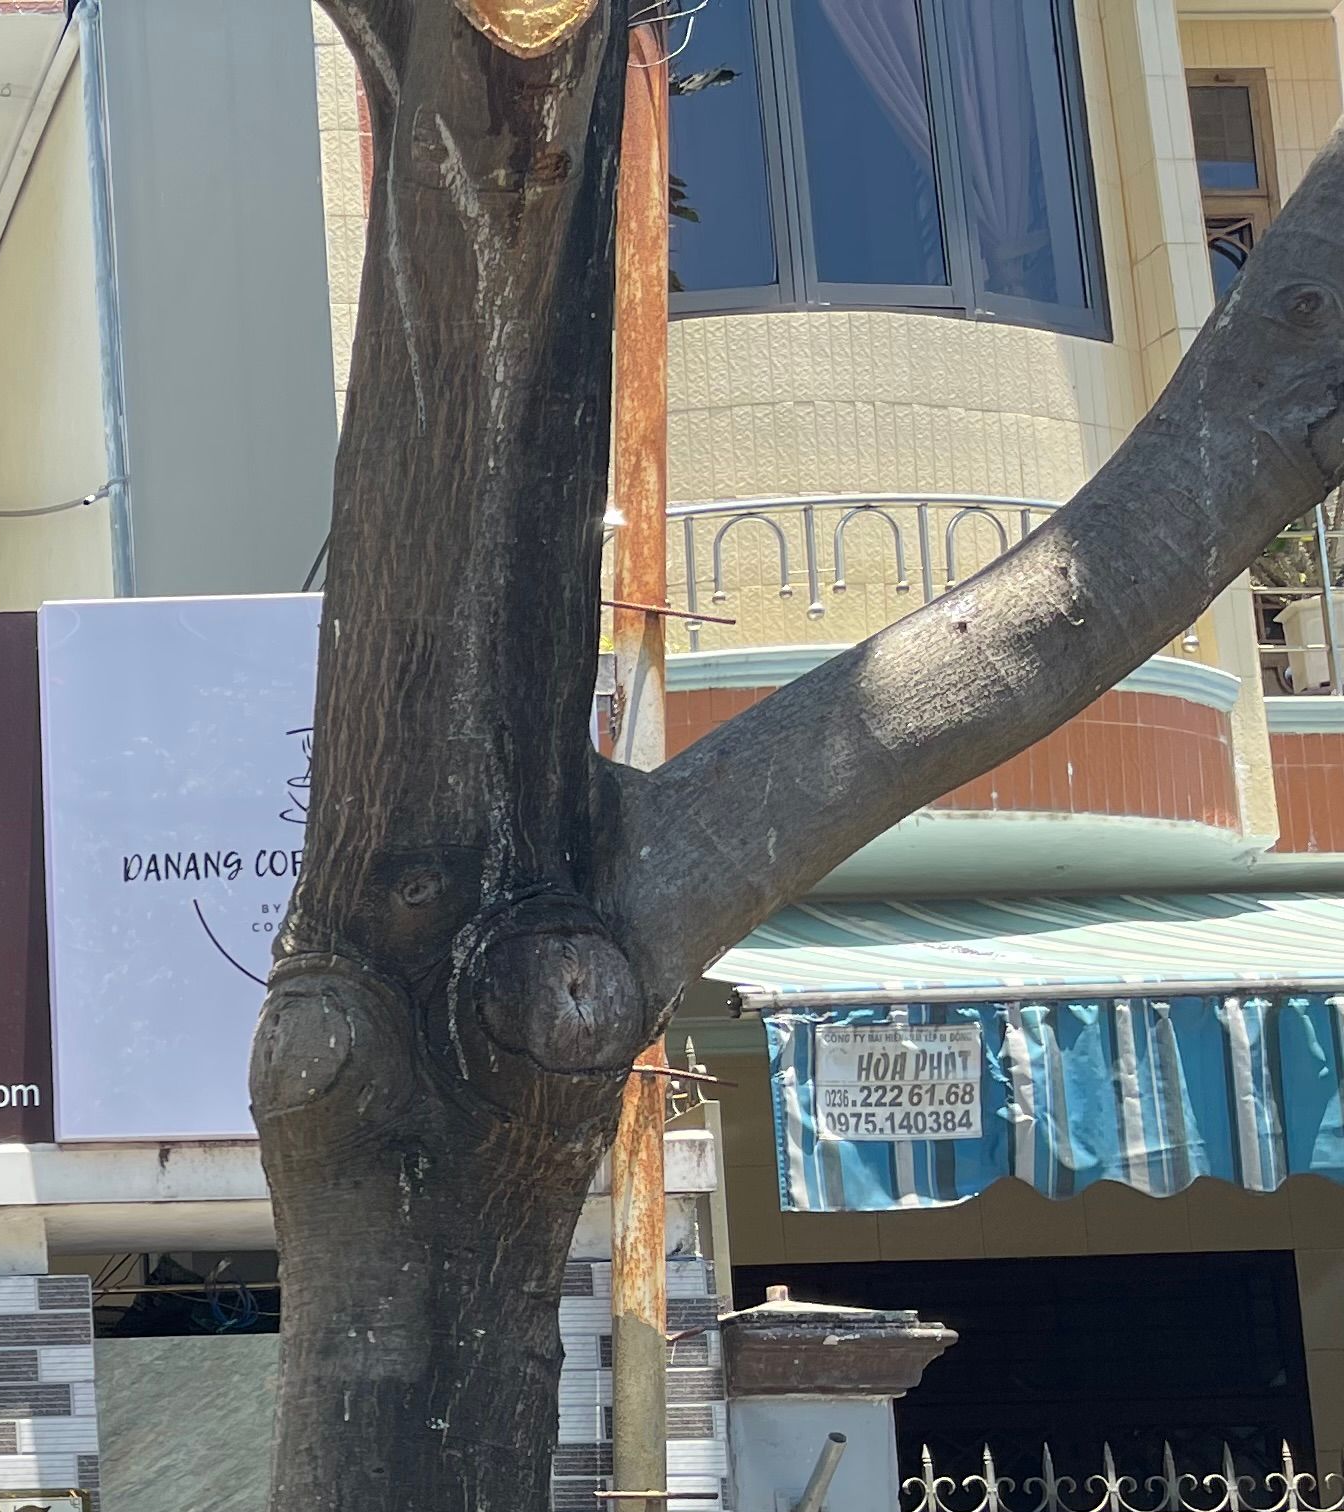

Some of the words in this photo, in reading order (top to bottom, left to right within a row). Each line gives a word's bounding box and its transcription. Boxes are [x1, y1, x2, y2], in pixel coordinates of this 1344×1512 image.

[123, 850, 243, 882] DANANG
[255, 849, 303, 877] COF
[261, 904, 282, 914] BY
[856, 1047, 908, 1081] HÒA
[913, 1046, 972, 1081] PHÁT
[908, 1082, 975, 1107] 61.68
[826, 1109, 973, 1135] 0975.140384
